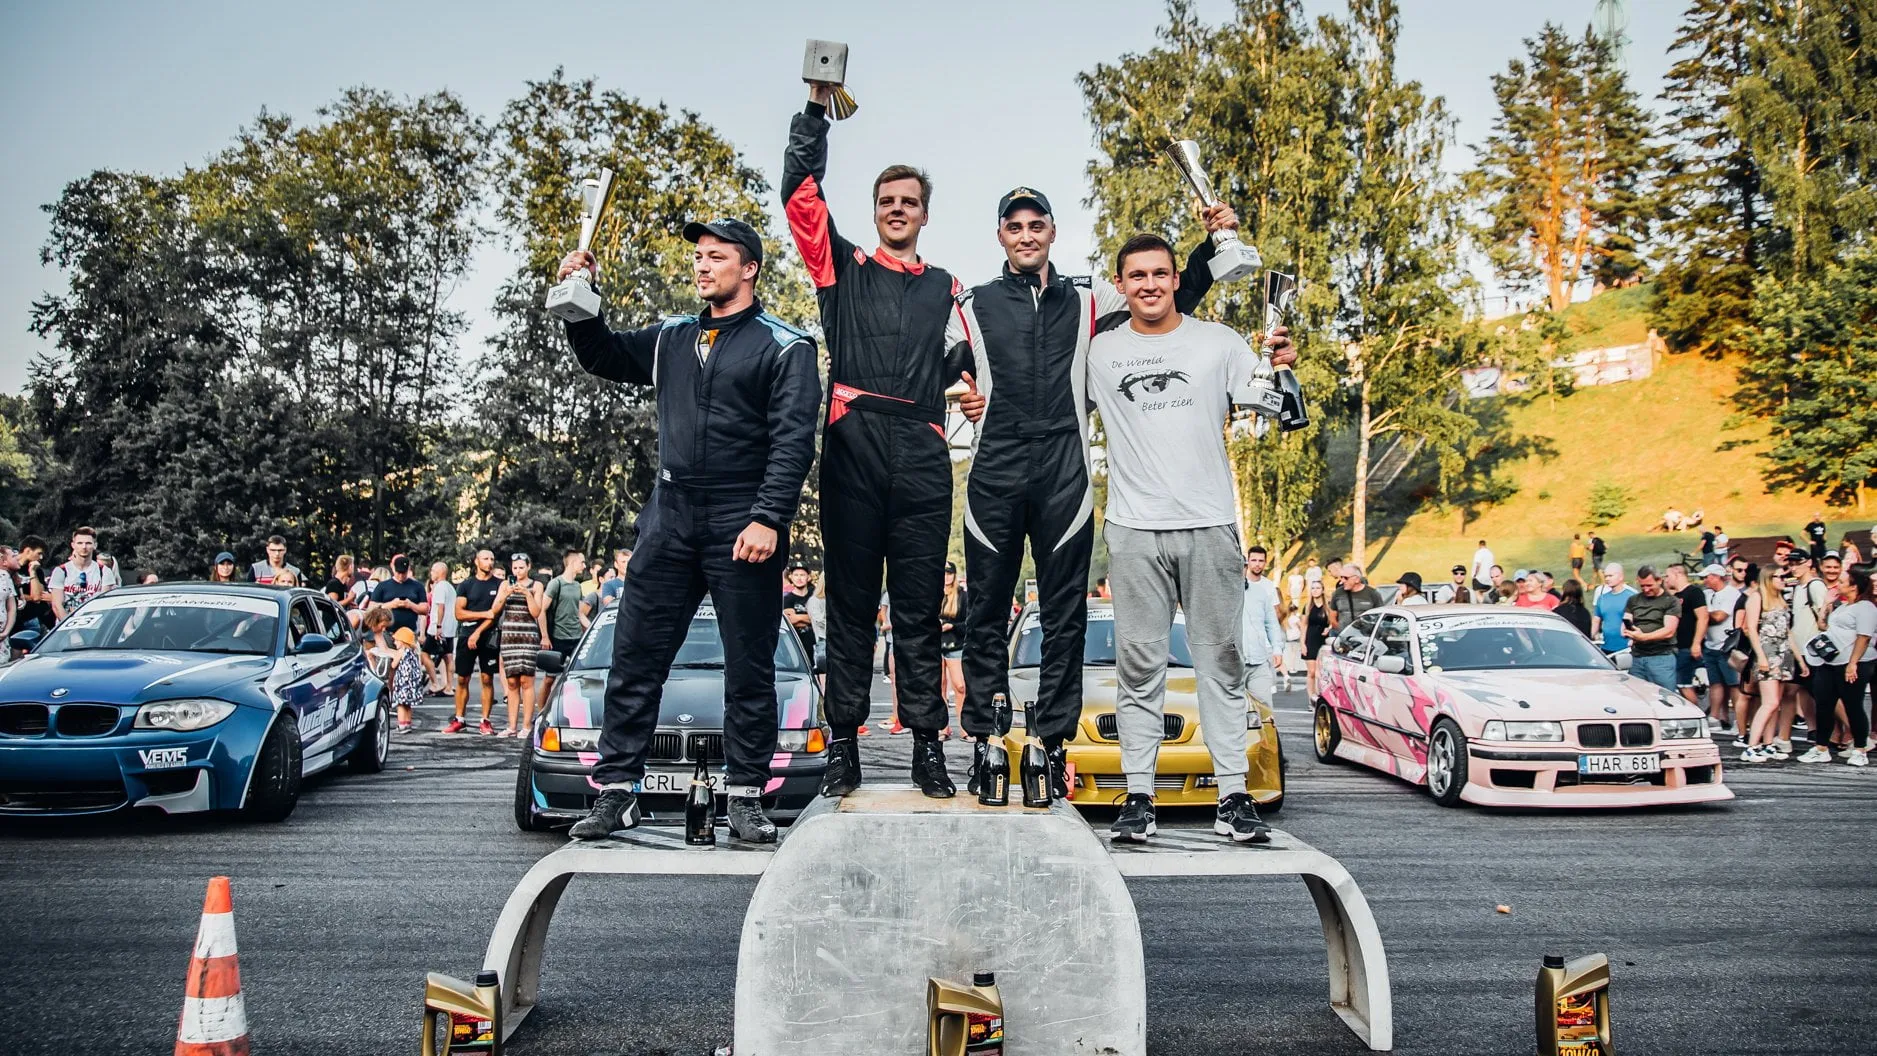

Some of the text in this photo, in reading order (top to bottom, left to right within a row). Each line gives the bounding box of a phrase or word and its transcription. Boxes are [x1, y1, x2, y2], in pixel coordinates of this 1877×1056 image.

[1111, 355, 1165, 369] De Wereld
[1142, 395, 1194, 411] Beter zien
[65, 616, 94, 627] 63
[1420, 621, 1444, 631] 59
[1590, 756, 1656, 771] HAR 681
[644, 775, 683, 791] CRL
